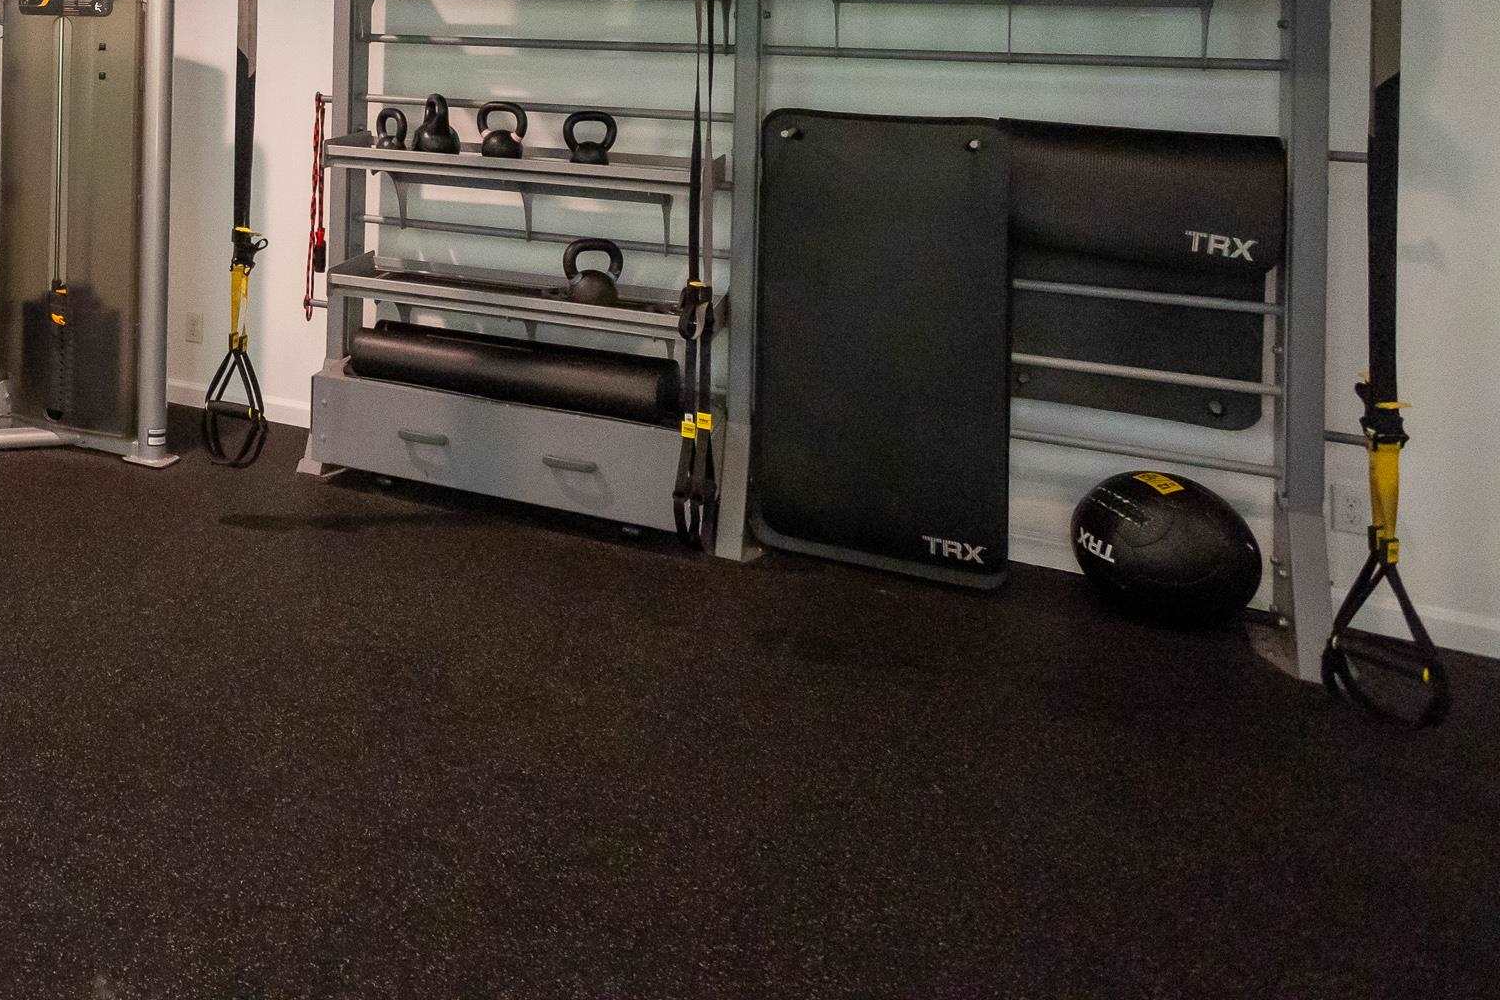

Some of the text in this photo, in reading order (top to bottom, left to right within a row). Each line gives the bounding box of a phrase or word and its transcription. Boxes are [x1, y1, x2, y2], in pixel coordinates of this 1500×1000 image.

[1184, 230, 1259, 261] TRX
[922, 535, 988, 564] TRX
[1078, 526, 1115, 563] TRX
